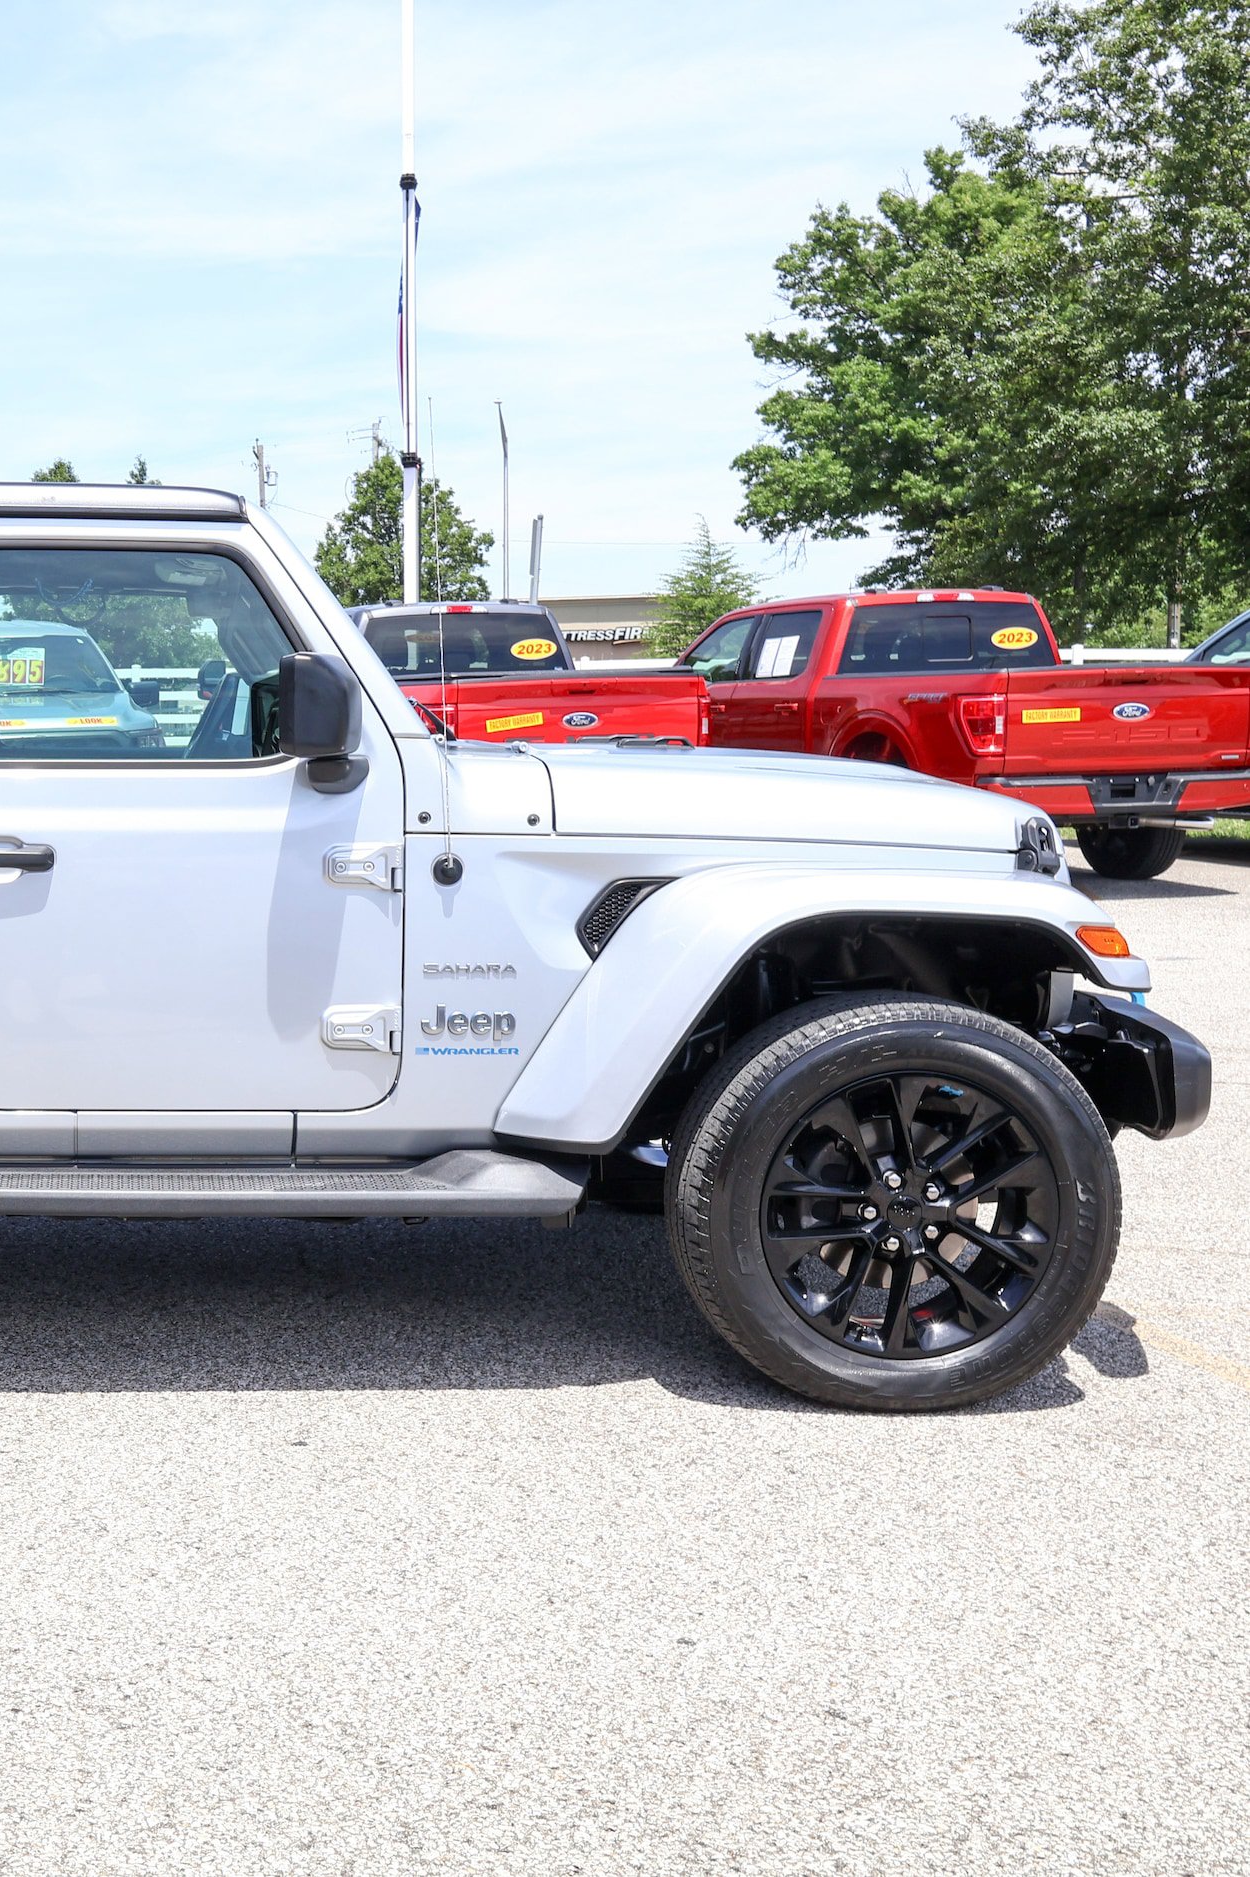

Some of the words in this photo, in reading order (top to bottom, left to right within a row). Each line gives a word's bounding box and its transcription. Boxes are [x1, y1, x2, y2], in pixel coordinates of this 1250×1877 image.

[998, 632, 1033, 644] 2023
[517, 643, 552, 655] 2023
[1025, 710, 1048, 721] FACTORY
[1049, 709, 1078, 720] WARRANTY
[489, 718, 512, 731] FACTORY
[513, 714, 540, 728] WARRANTY
[423, 963, 517, 977] SAHARA
[421, 1003, 517, 1041] Jeep
[431, 1047, 519, 1056] WRANGLER
